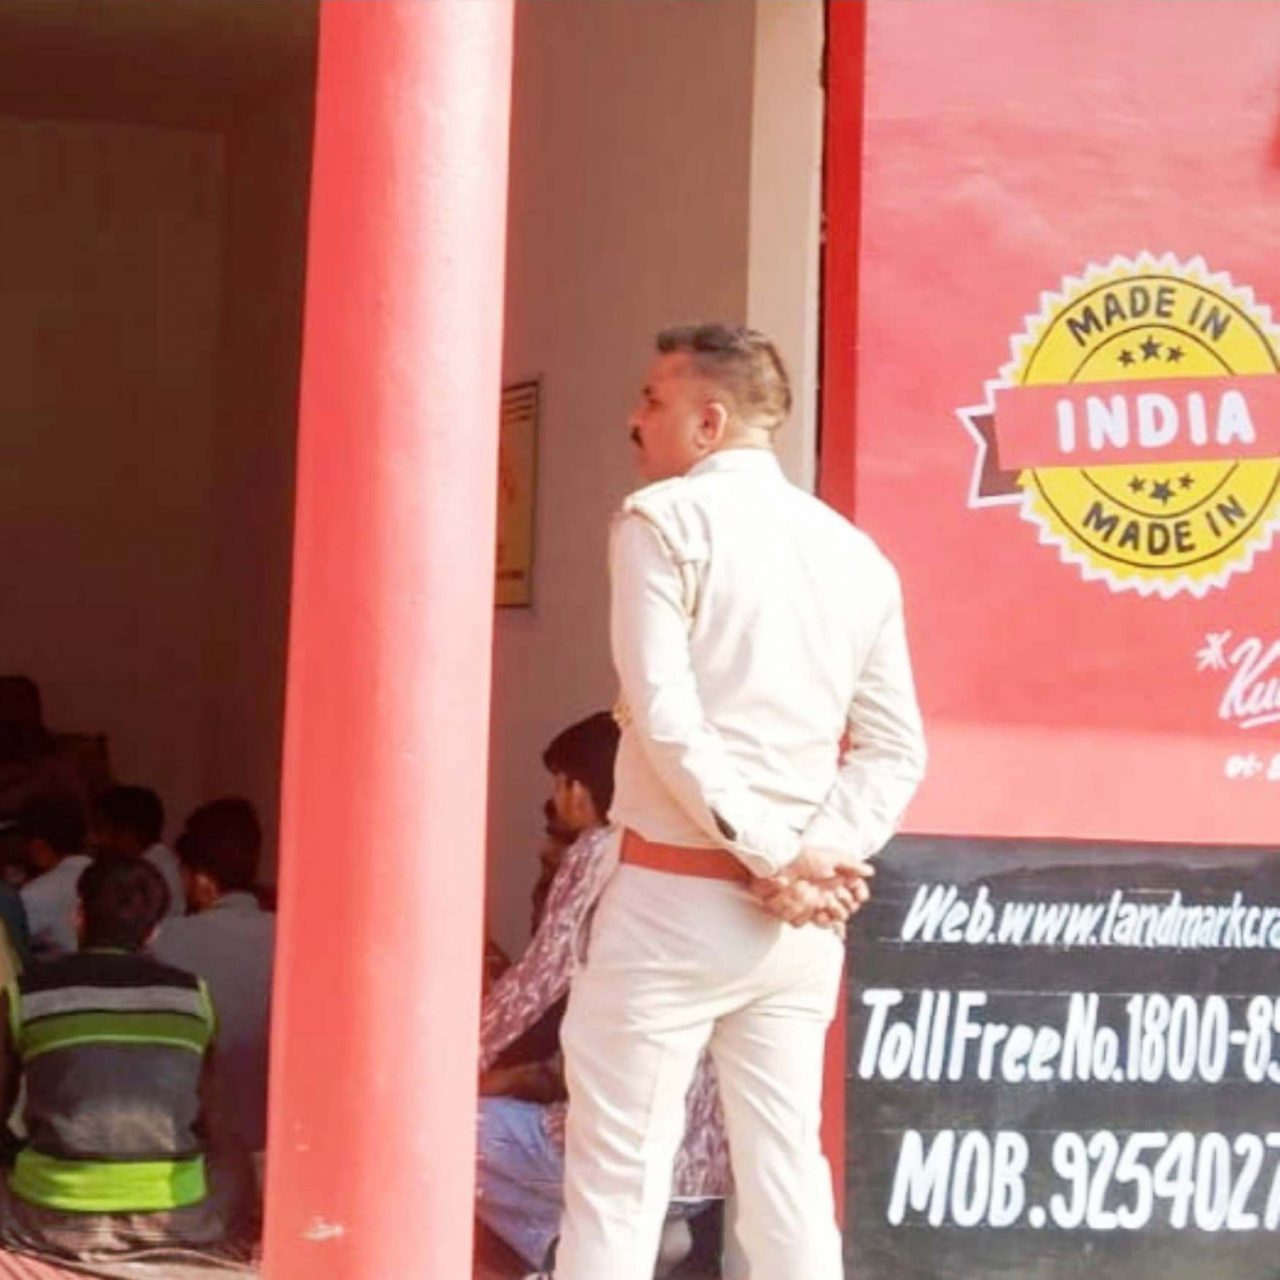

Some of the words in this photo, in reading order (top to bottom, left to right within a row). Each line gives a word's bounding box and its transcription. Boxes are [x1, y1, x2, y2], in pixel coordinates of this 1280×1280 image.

[1066, 286, 1176, 347] MADE
[1189, 296, 1231, 342] IN
[1056, 390, 1255, 454] INDIA
[1081, 501, 1195, 556] MADE
[1205, 494, 1247, 538] IN
